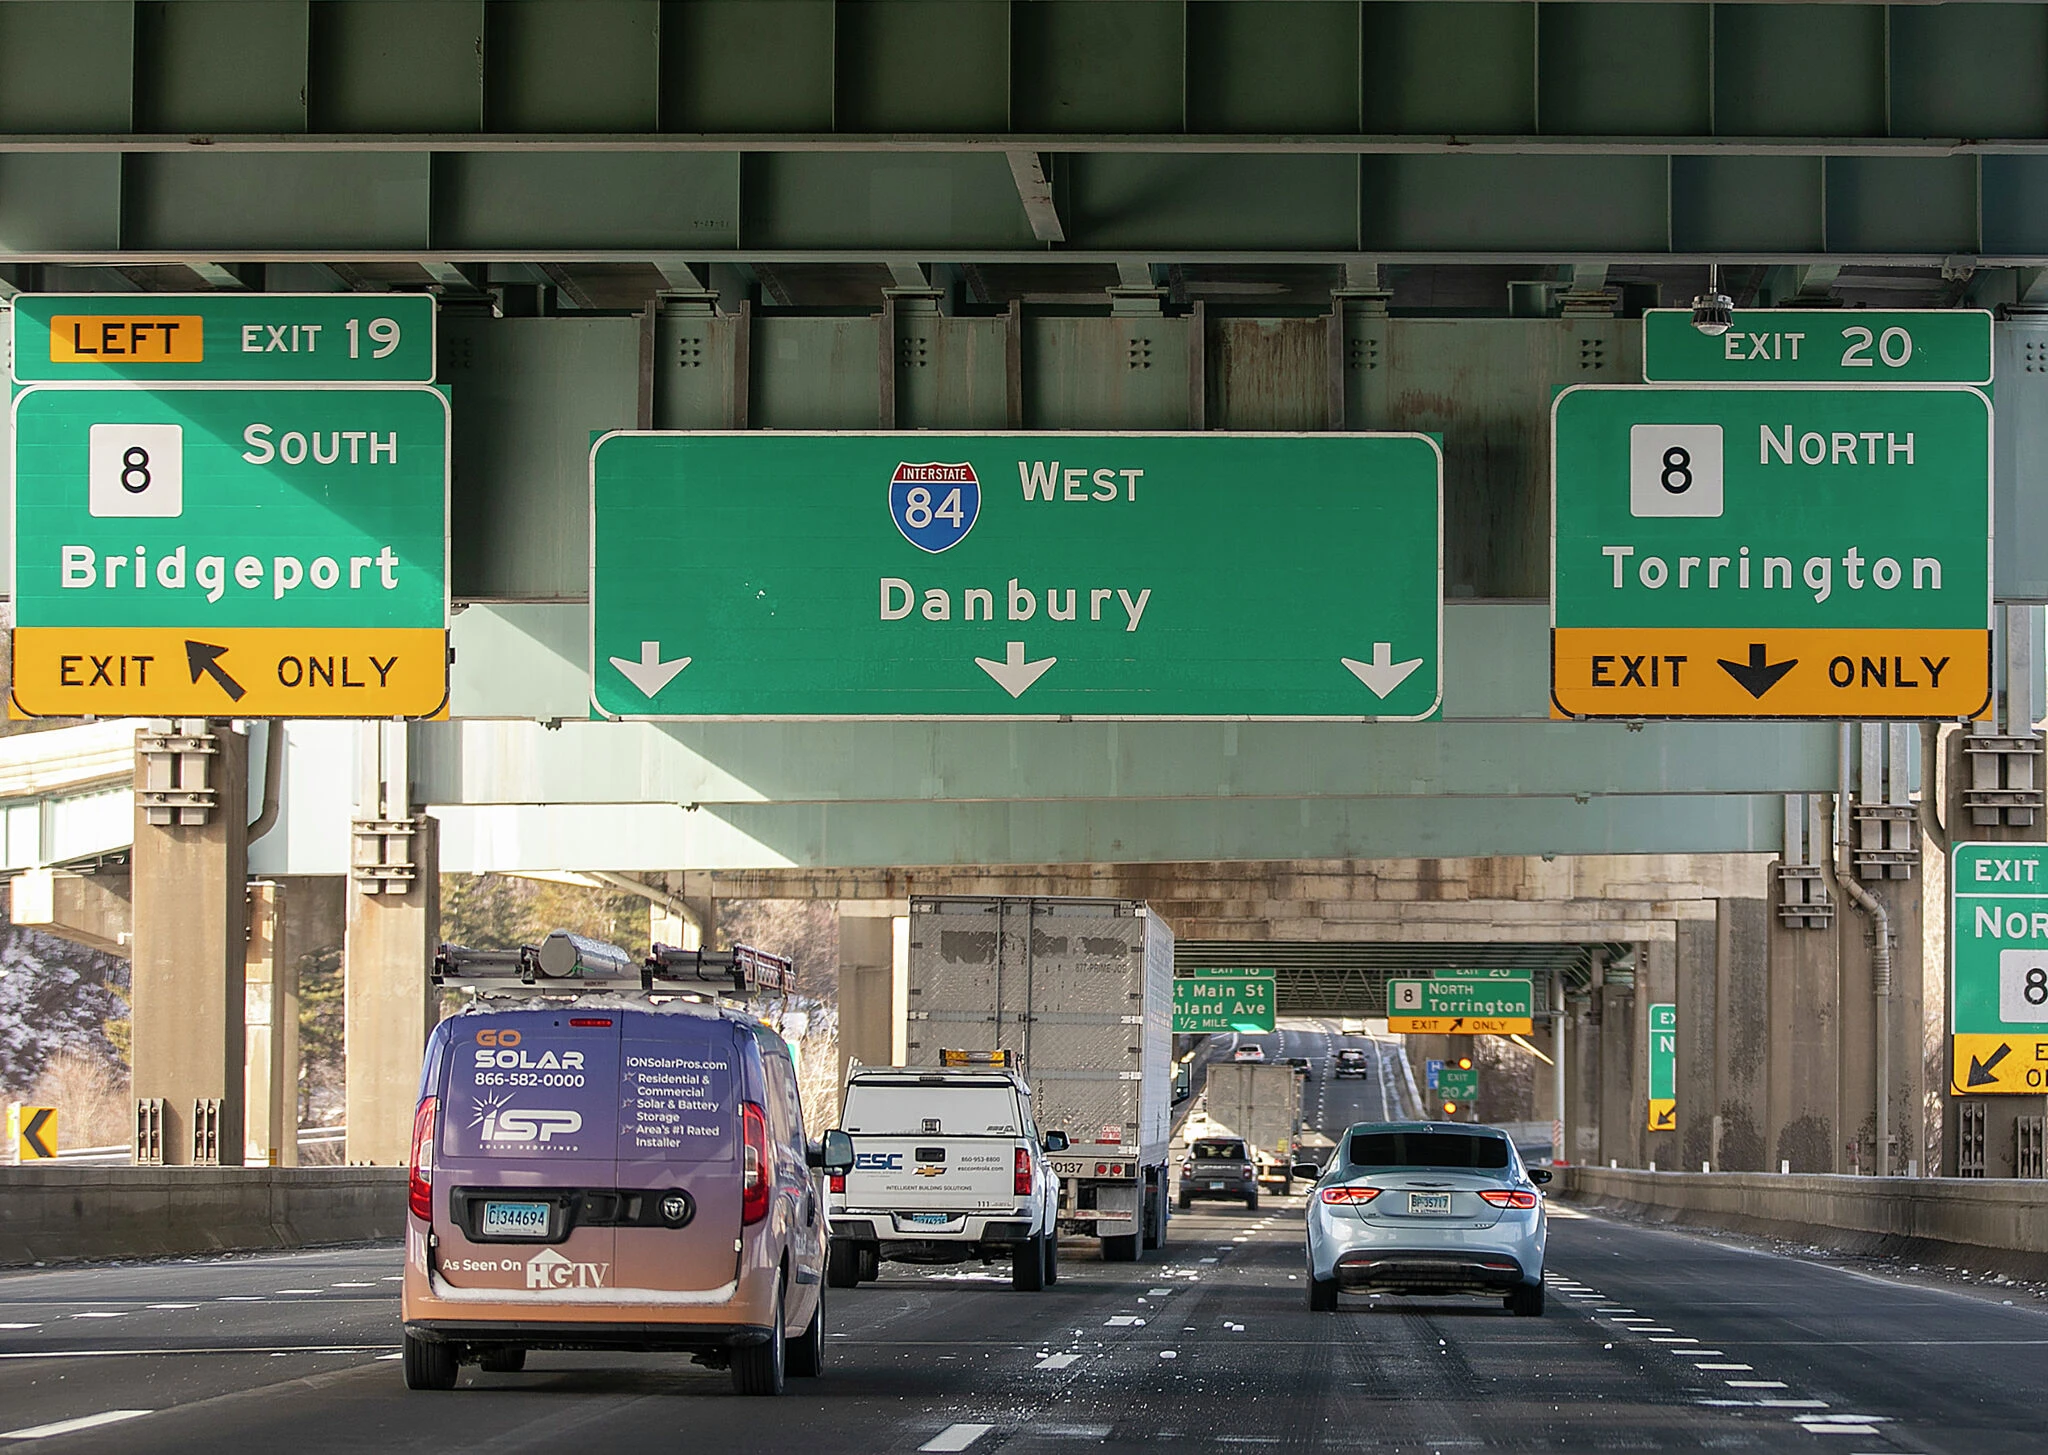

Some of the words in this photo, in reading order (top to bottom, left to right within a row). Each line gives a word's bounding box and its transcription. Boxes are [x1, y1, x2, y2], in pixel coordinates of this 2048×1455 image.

[73, 322, 181, 354] LEFT
[241, 325, 322, 353] EXIT
[345, 317, 402, 359] 19
[1724, 333, 1806, 361] EXIT
[1840, 327, 1914, 368] 20
[241, 423, 398, 465] SOUTH
[1758, 424, 1916, 465] NORTH
[120, 446, 151, 493] 8
[902, 468, 968, 481] INTERSTATE
[1660, 446, 1693, 495] 8
[1018, 461, 1144, 502] WEST
[905, 487, 965, 529] 84
[60, 544, 400, 602] Bridgeport
[1601, 546, 1943, 604] Torrington
[880, 577, 1152, 632] Danbury
[60, 655, 154, 687] EXIT
[277, 655, 399, 688] ONLY
[1591, 655, 1688, 688] EXIT
[1828, 655, 1951, 689] ONLY
[1975, 859, 2039, 882] EXIT
[1193, 984, 1235, 997] Main
[1245, 984, 1264, 997] St
[1428, 983, 1474, 995] NORTH
[2024, 968, 2048, 1005] 8
[1404, 989, 1413, 1003] 8
[1232, 1001, 1266, 1014] Ave
[1429, 999, 1525, 1015] Torrington
[1202, 1018, 1228, 1027] MILE
[1412, 1020, 1439, 1030] EXIT
[1472, 1020, 1507, 1030] ONLY
[476, 1029, 521, 1047] GO
[474, 1049, 585, 1070] SOLAR
[626, 1057, 727, 1070] iONSolarPros.com
[474, 1072, 585, 1087] 866-582-0000
[638, 1073, 699, 1084] Residential
[701, 1075, 710, 1084] &
[1447, 1073, 1468, 1082] EXIT
[637, 1086, 704, 1097] Commercial
[1441, 1086, 1459, 1098] 20
[637, 1099, 665, 1109] Solar
[667, 1100, 675, 1109] &
[678, 1100, 719, 1113] Battery
[636, 1112, 680, 1124] Storage
[636, 1124, 670, 1135] Area's
[672, 1125, 684, 1135] #1
[687, 1125, 720, 1137] Rated
[635, 1137, 681, 1148] Installer
[855, 1153, 903, 1170] ESC
[443, 1259, 460, 1270] As
[462, 1259, 497, 1271] Seen
[500, 1259, 521, 1271] On
[526, 1259, 609, 1289] HGTV
